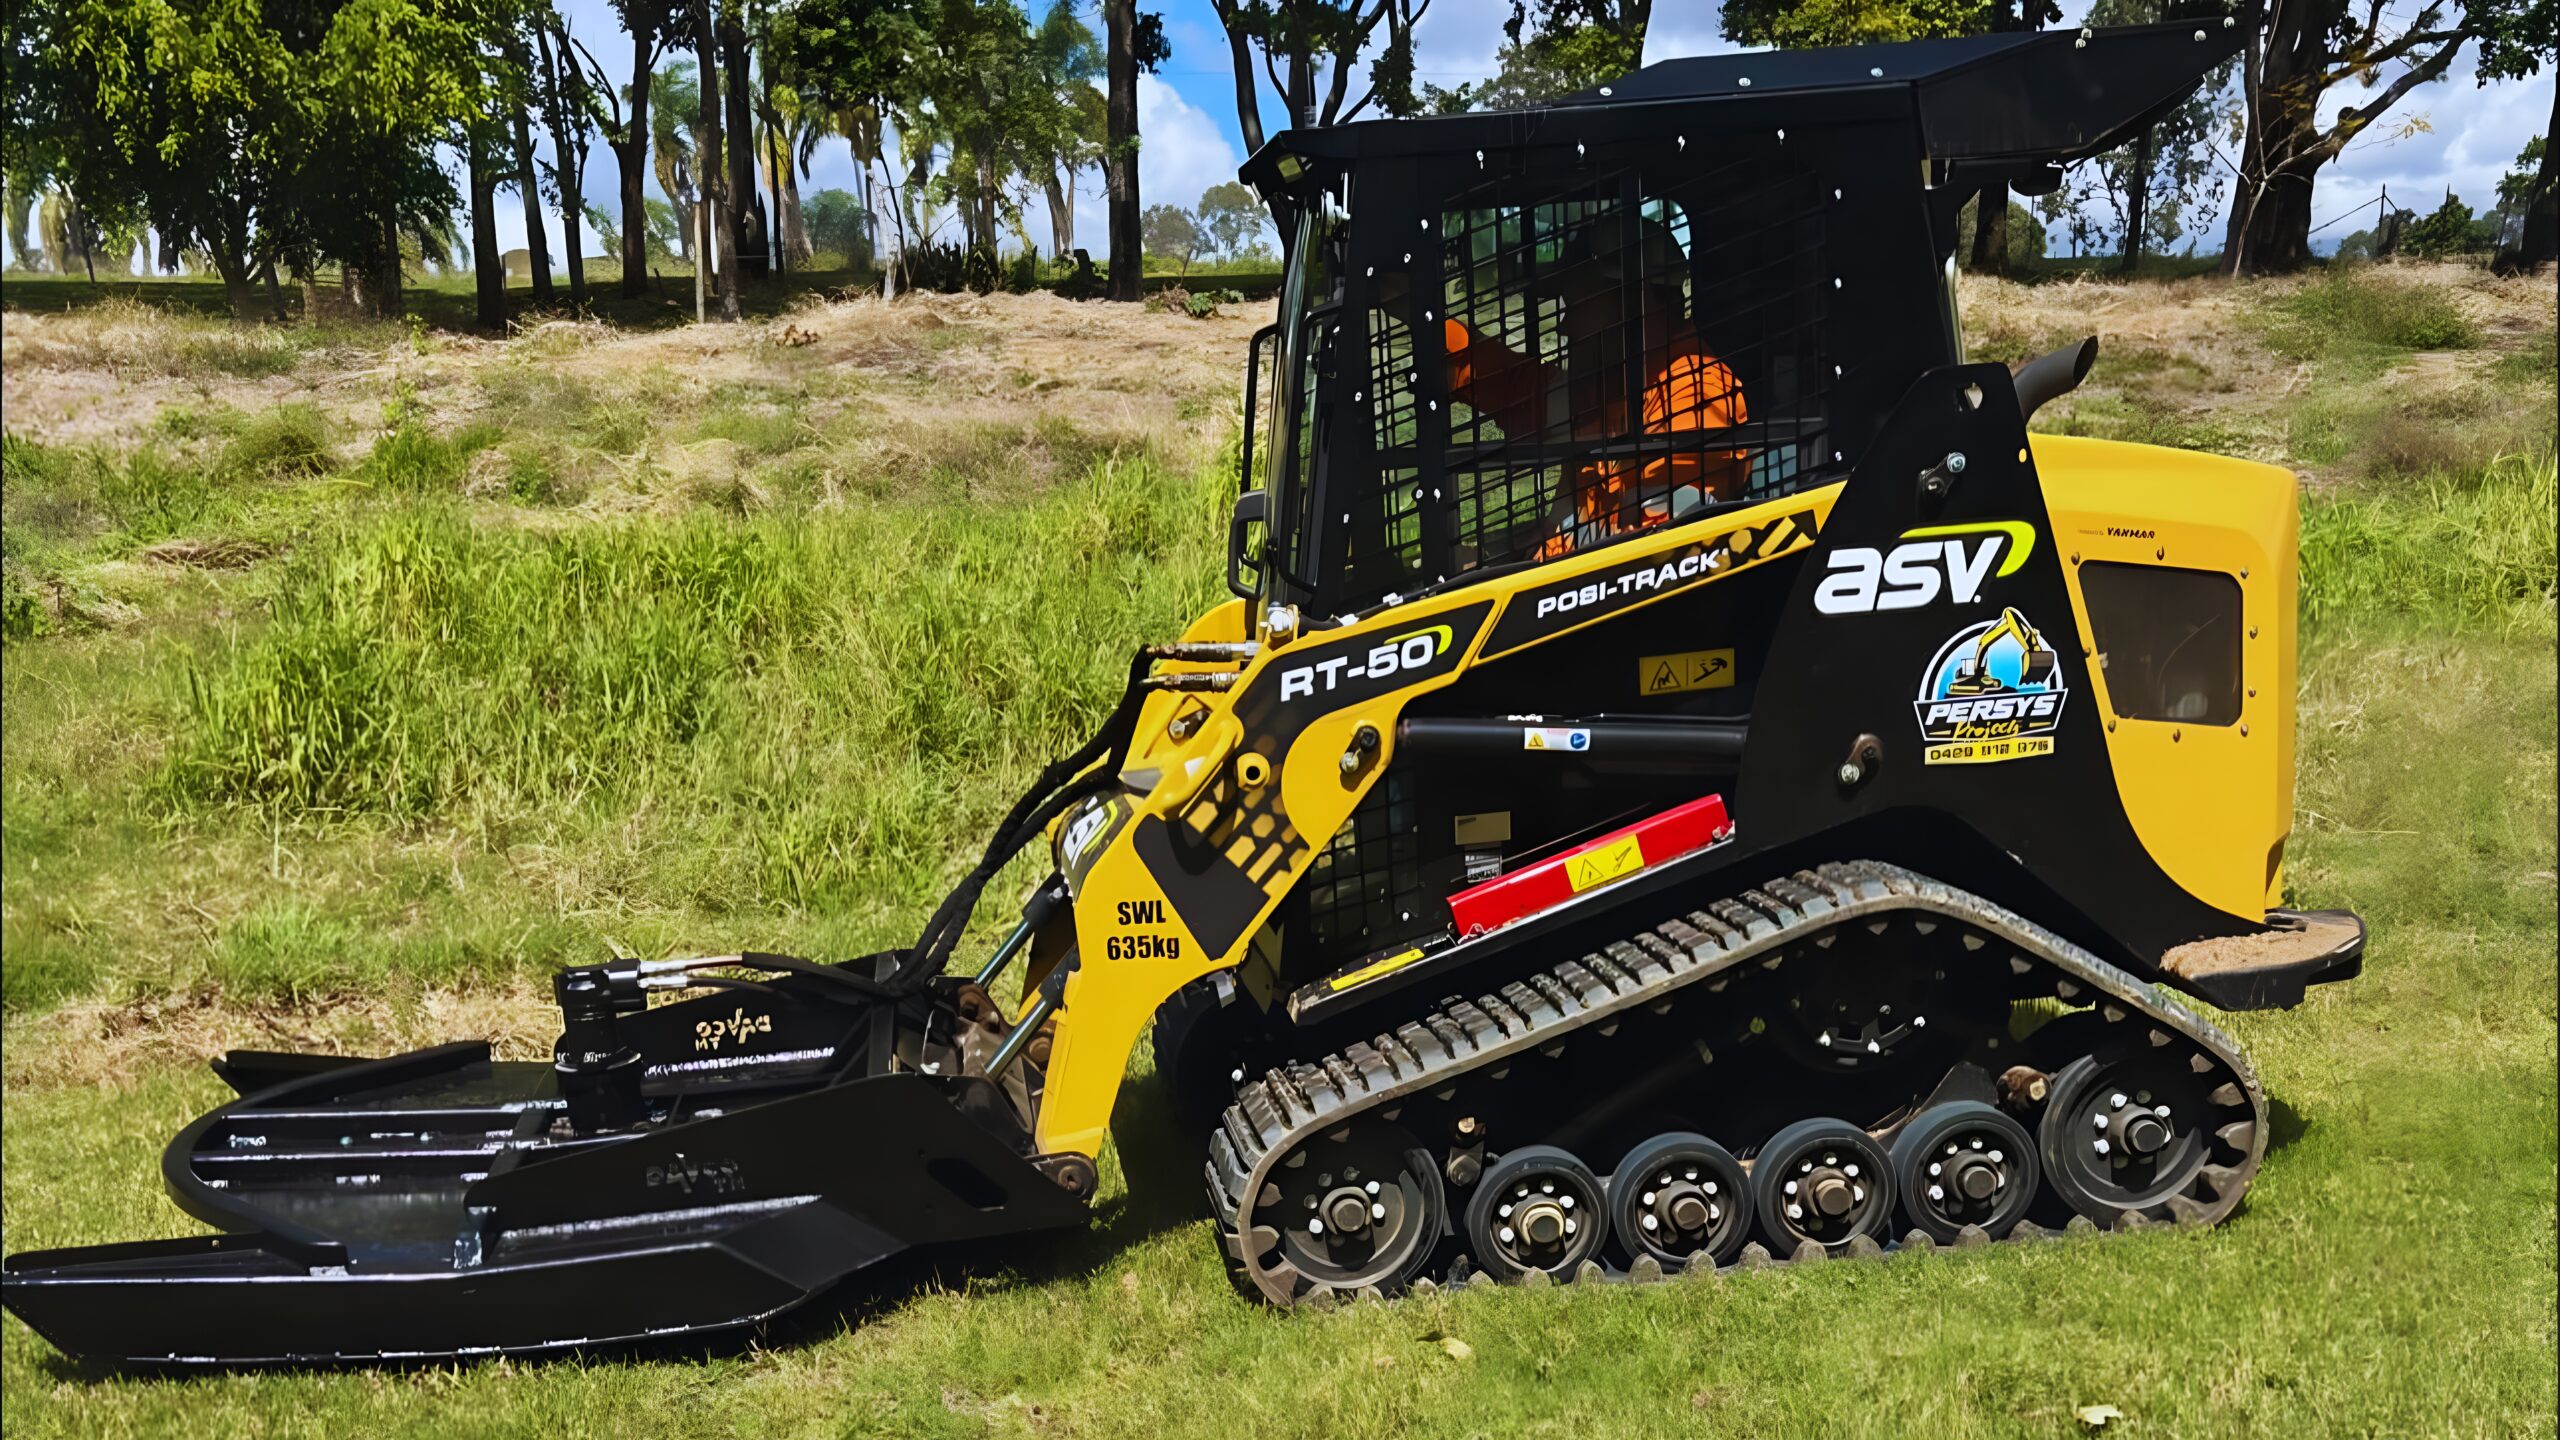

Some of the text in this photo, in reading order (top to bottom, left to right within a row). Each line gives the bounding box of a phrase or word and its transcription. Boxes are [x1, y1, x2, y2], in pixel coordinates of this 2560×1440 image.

[1537, 548, 1720, 618] POSI-TRACK
[1280, 634, 1434, 702] RT-50
[1925, 693, 2058, 726] PERSYS
[1117, 900, 1167, 926] SWL
[1106, 934, 1180, 961] 635kg
